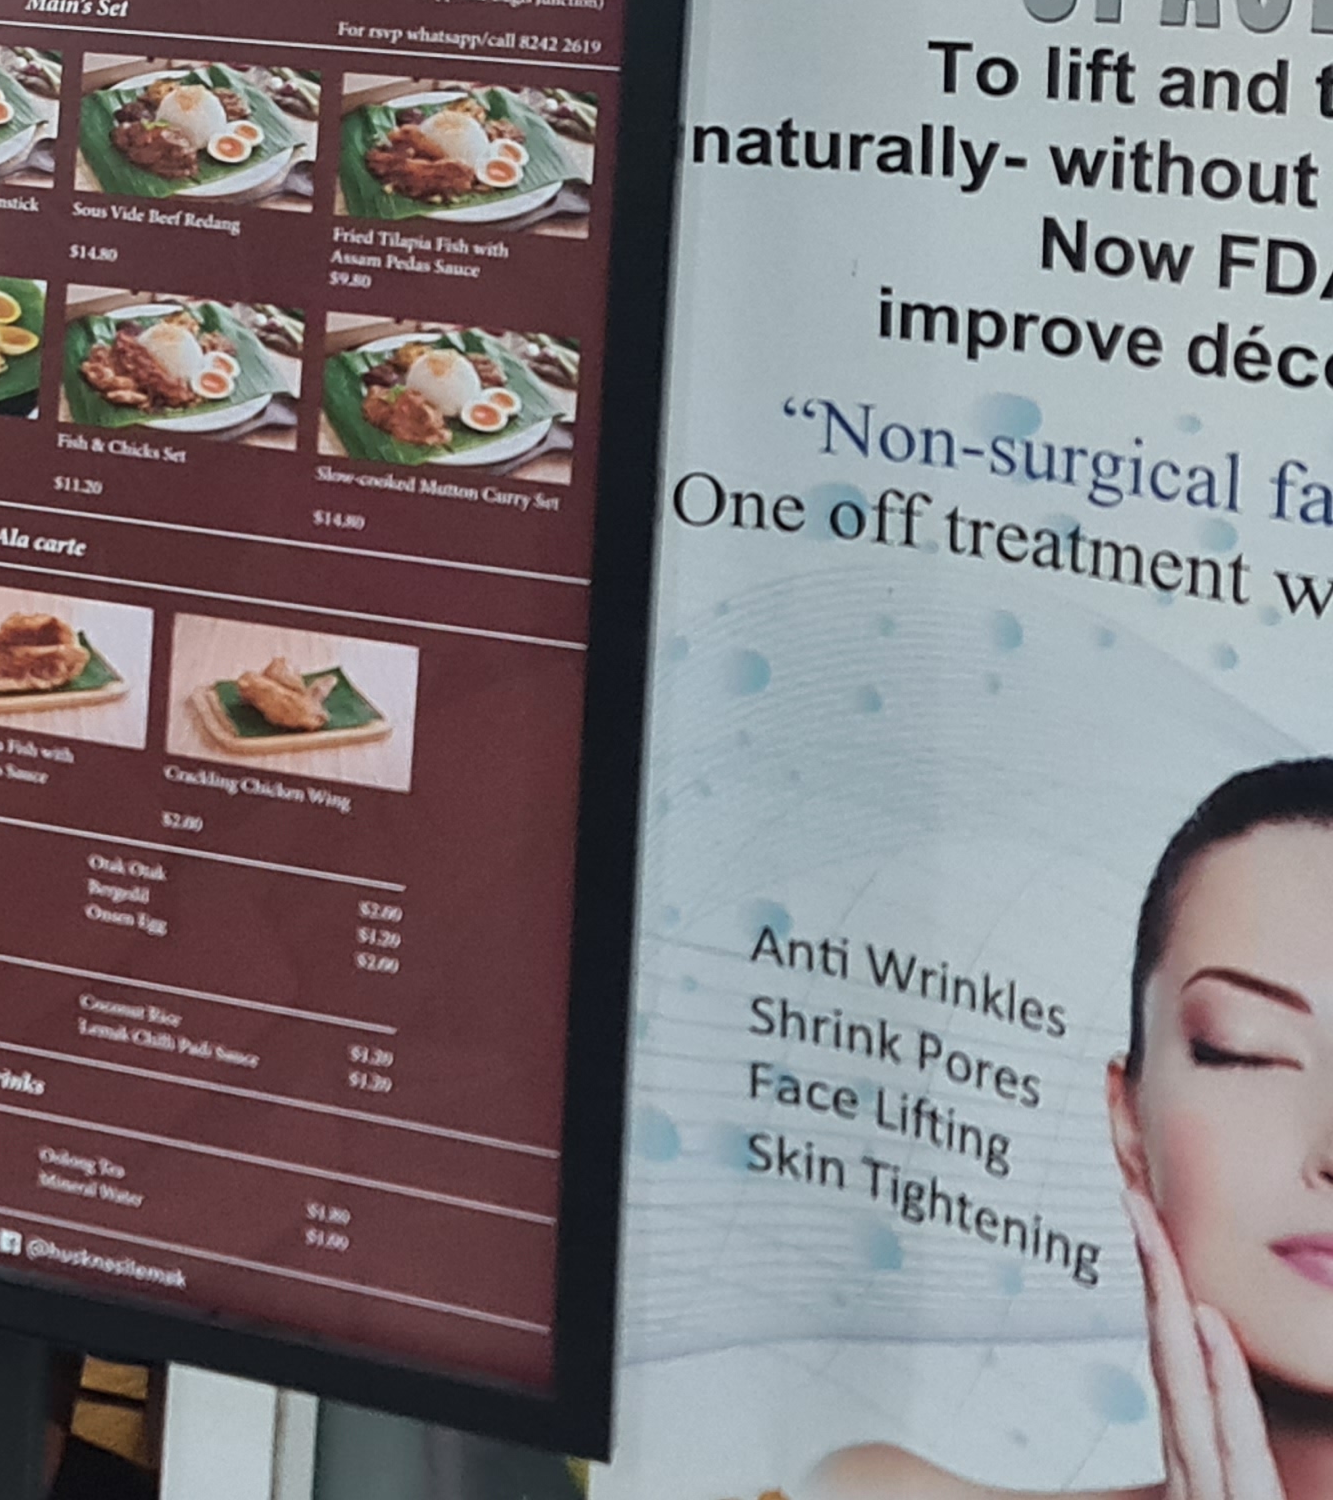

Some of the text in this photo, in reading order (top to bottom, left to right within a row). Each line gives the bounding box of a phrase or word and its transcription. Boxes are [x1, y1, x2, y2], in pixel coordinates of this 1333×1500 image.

[337, 21, 601, 55] For rsvp whatsapp/call 8242 2619
[928, 40, 1289, 114] To lift and
[691, 117, 1319, 208] naturally- without
[73, 202, 241, 235] Sous Vide Beef Redang
[69, 245, 118, 262] $14.80
[331, 250, 480, 278] Assam Pedas Sauce
[333, 227, 509, 259] Fried Tilapia Fish with
[1040, 216, 1333, 297] Now FD
[330, 272, 372, 289] $9.80
[879, 286, 1333, 388] improve déc
[57, 432, 186, 463] Fish & Chicks Set
[316, 465, 560, 511] Slow-cooked Mutton Curry Set
[34, 530, 88, 558] carte
[672, 470, 806, 533] One
[829, 488, 934, 548] off
[946, 505, 1251, 605] treatment
[240, 776, 305, 802] Chicken
[750, 924, 1067, 1038] Anti Wrinkles
[748, 996, 1041, 1108] Shrink Pores
[749, 1062, 1010, 1178] Face Lifting
[747, 1132, 1101, 1288] Skin Tightening
